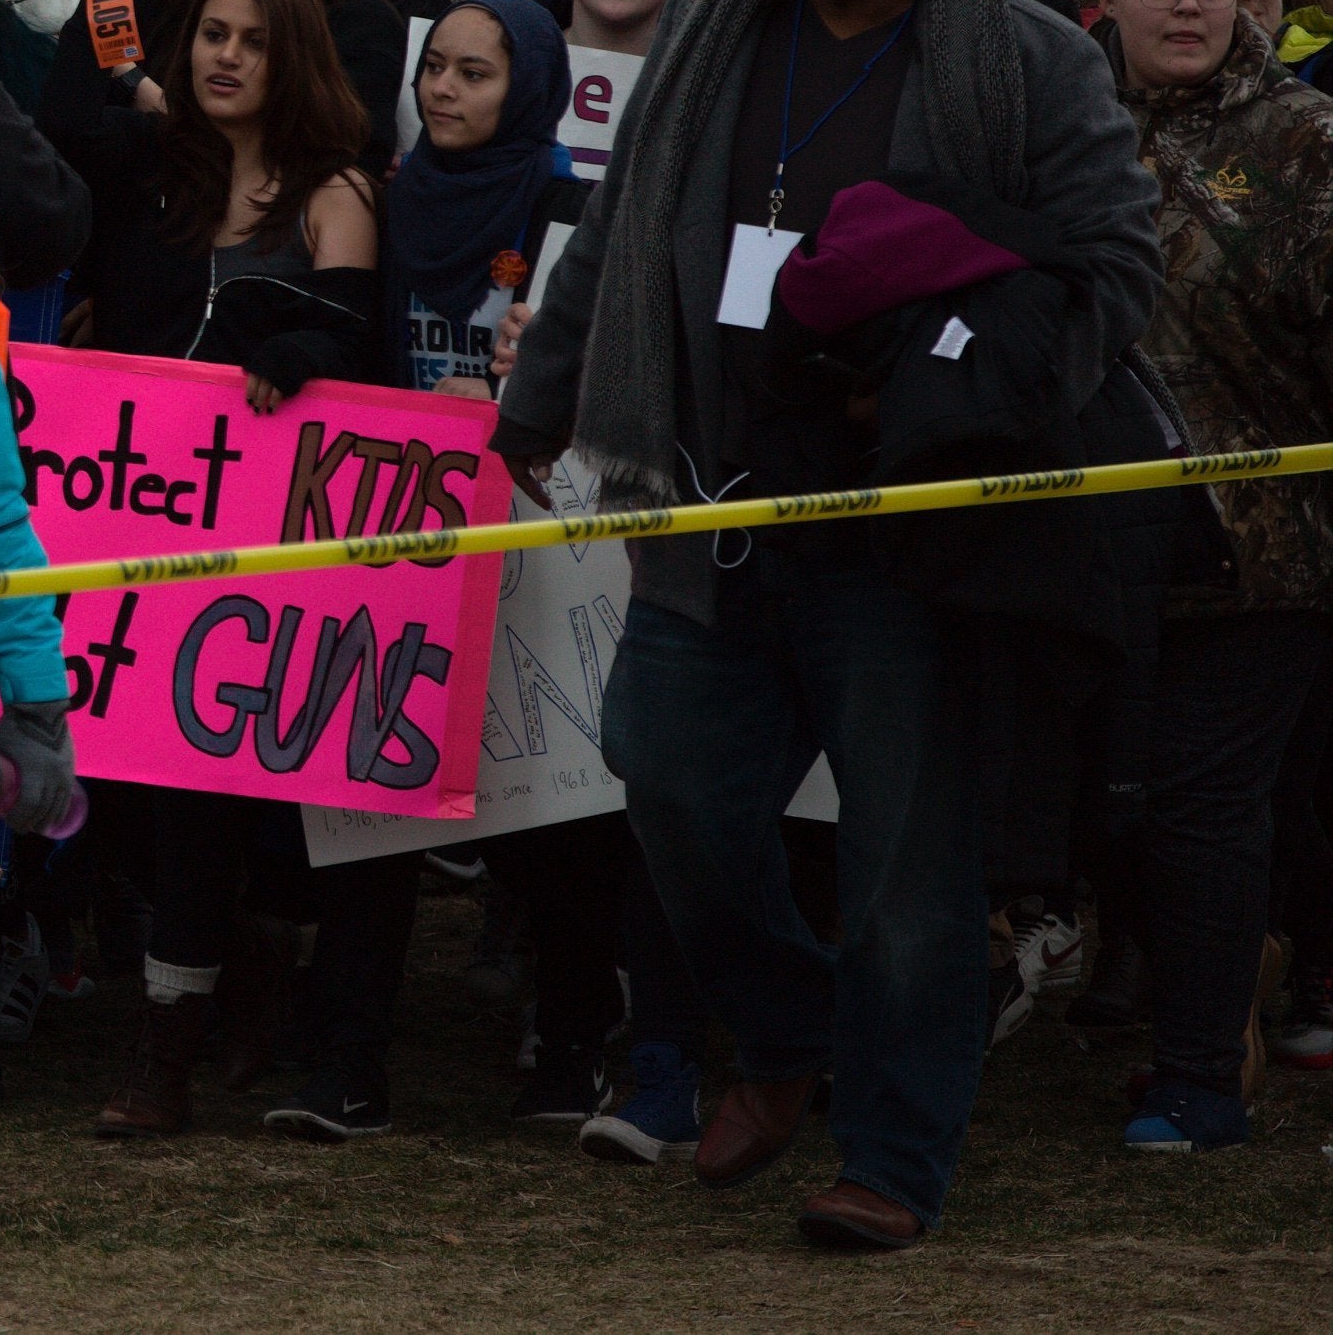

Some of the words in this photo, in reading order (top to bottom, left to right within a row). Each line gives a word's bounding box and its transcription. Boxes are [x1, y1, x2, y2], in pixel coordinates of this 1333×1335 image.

[173, 594, 453, 791] GUNS
[504, 784, 533, 801] since
[552, 771, 590, 795] 1968
[601, 772, 612, 785] is
